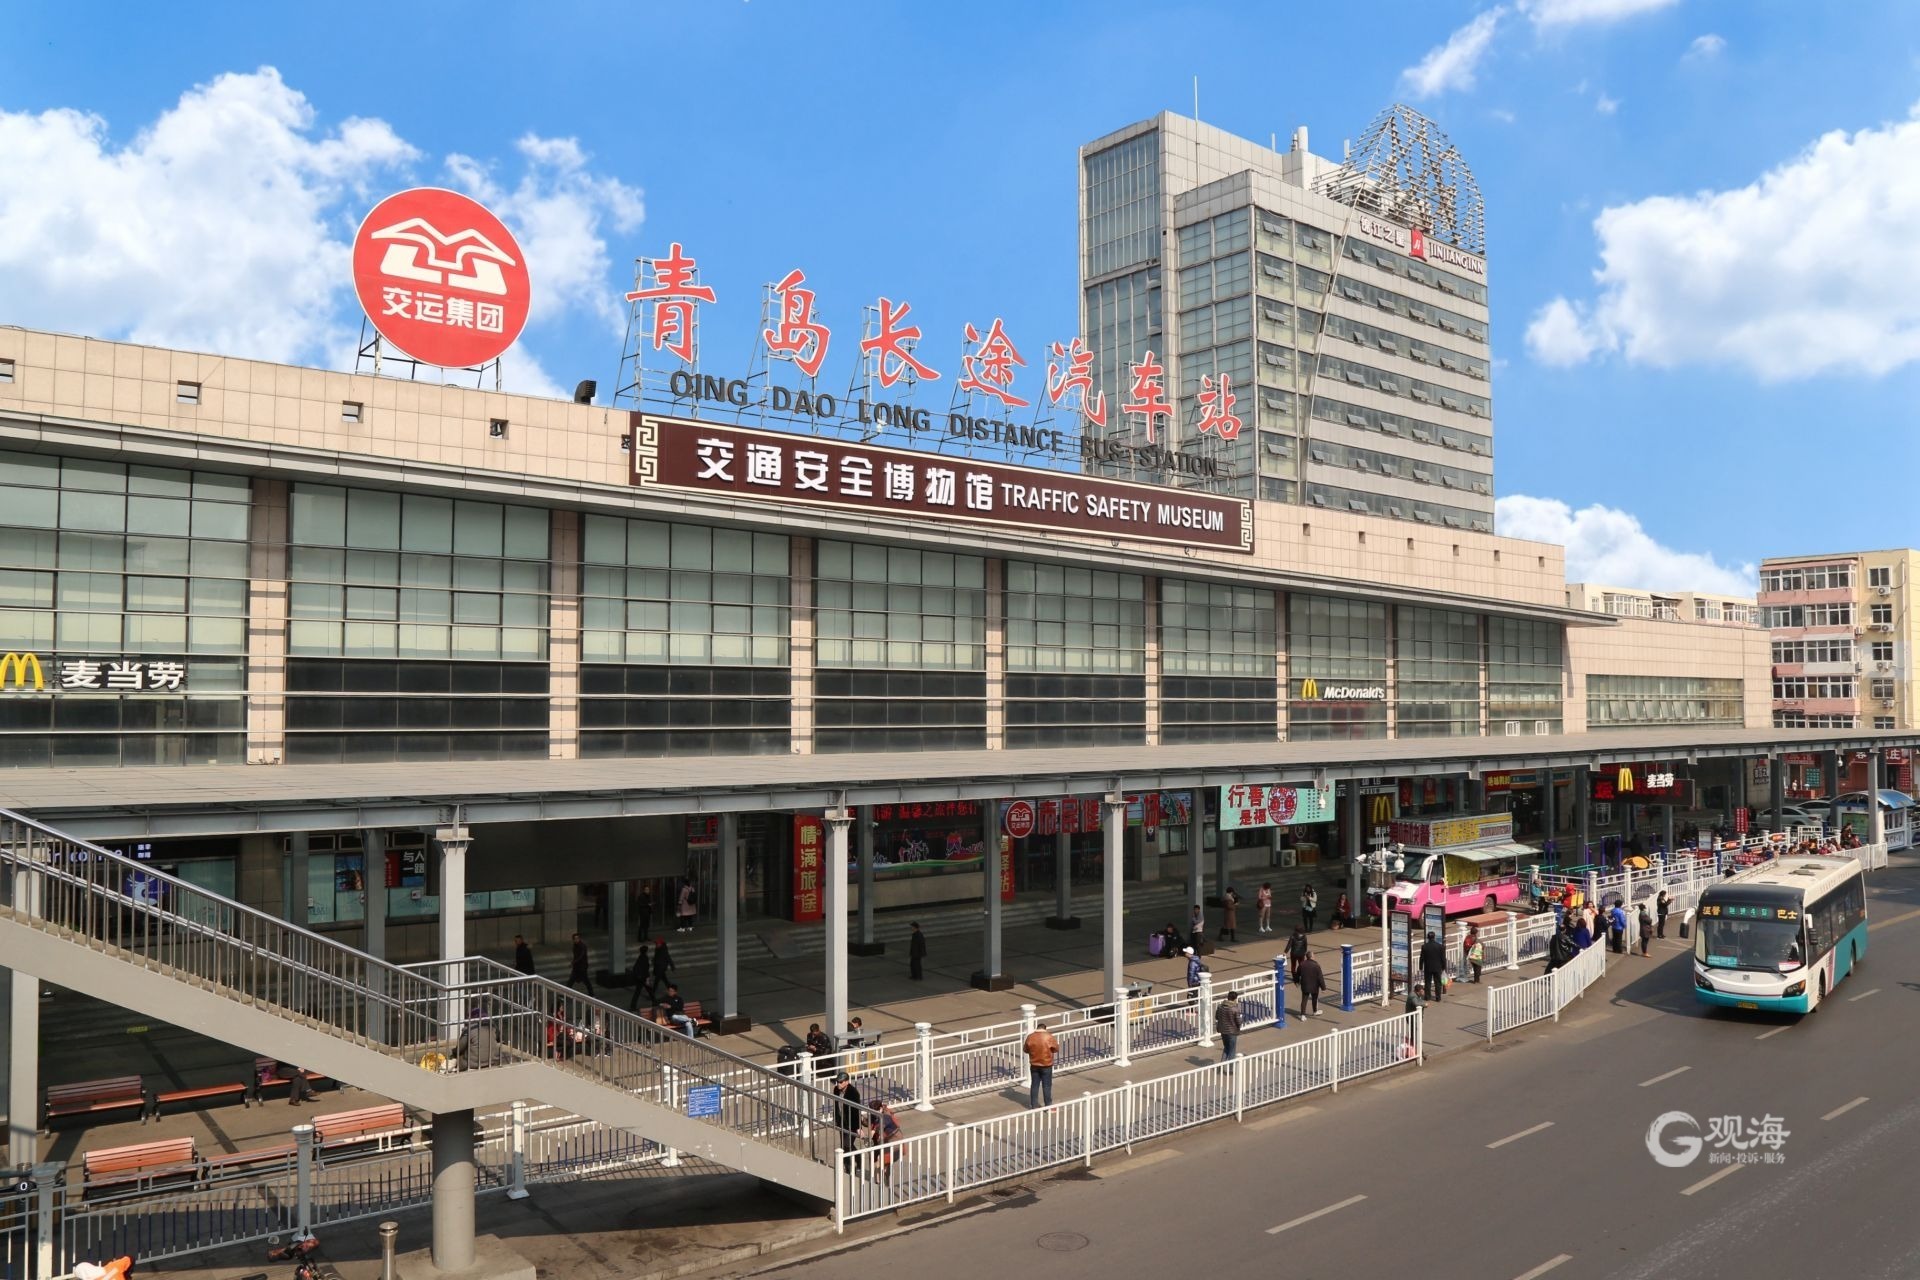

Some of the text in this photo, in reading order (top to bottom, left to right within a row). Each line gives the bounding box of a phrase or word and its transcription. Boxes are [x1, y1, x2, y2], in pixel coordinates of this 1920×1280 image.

[1360, 215, 1405, 248] 锦江之星
[1429, 242, 1467, 268] JINJIANG
[1466, 256, 1484, 275] INN
[382, 286, 504, 334] 交运集团
[625, 242, 1243, 441] 青岛长途汽车站
[669, 370, 1219, 477] QING DAO LONG DISTANCE BUS STATION
[697, 437, 1225, 532] 交通安全博物馆 TRAFFIC SAFETY MUSEUM
[61, 660, 184, 691] 麦当劳
[1324, 686, 1385, 699] McDonald's
[1228, 784, 1264, 808] 行善
[1647, 773, 1675, 788] 麦当劳
[1239, 808, 1267, 826] 是福
[800, 825, 817, 914] 情满旅途
[1776, 909, 1799, 921] 巴士
